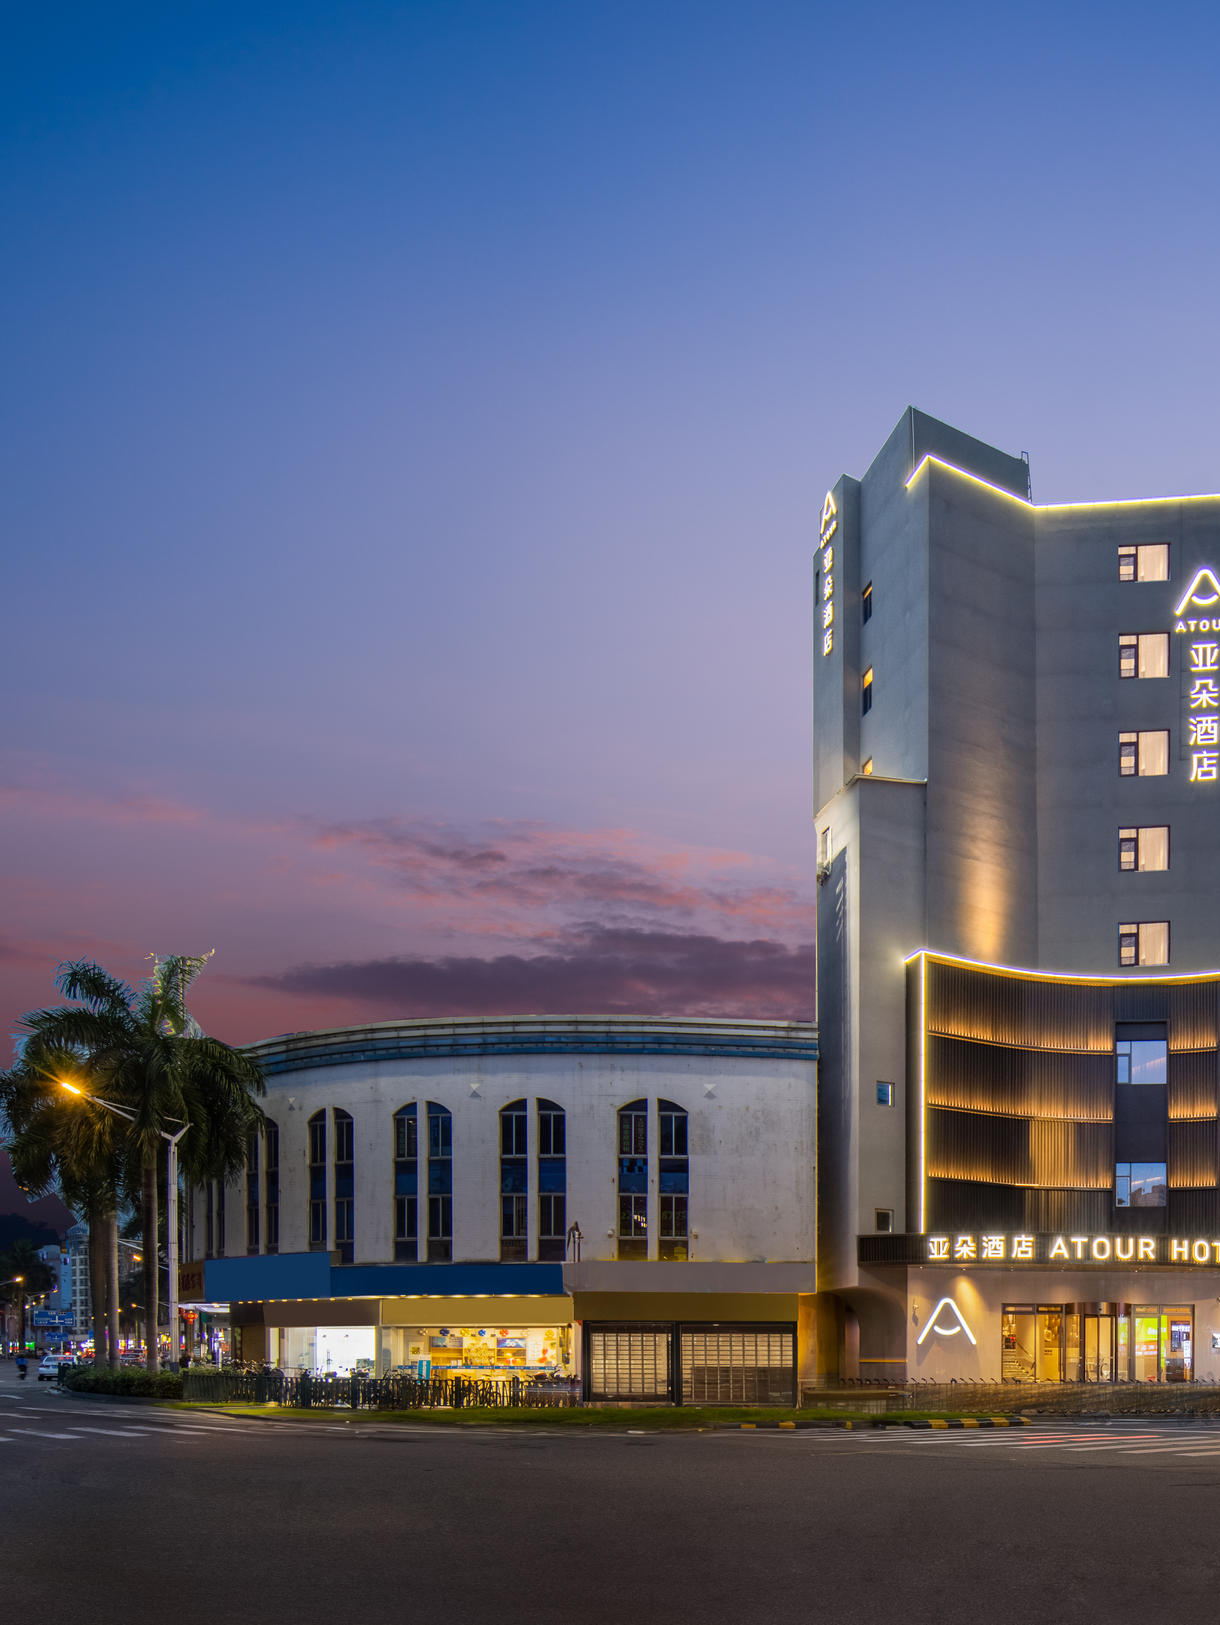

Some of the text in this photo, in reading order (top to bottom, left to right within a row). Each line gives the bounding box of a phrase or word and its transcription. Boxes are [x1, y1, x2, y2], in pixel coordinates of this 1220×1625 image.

[823, 546, 833, 656] 亚朵酒店
[1188, 640, 1220, 782] 亚朵酒店
[928, 1234, 1034, 1260] 亚朵酒店
[1049, 1236, 1156, 1261] ATOUR
